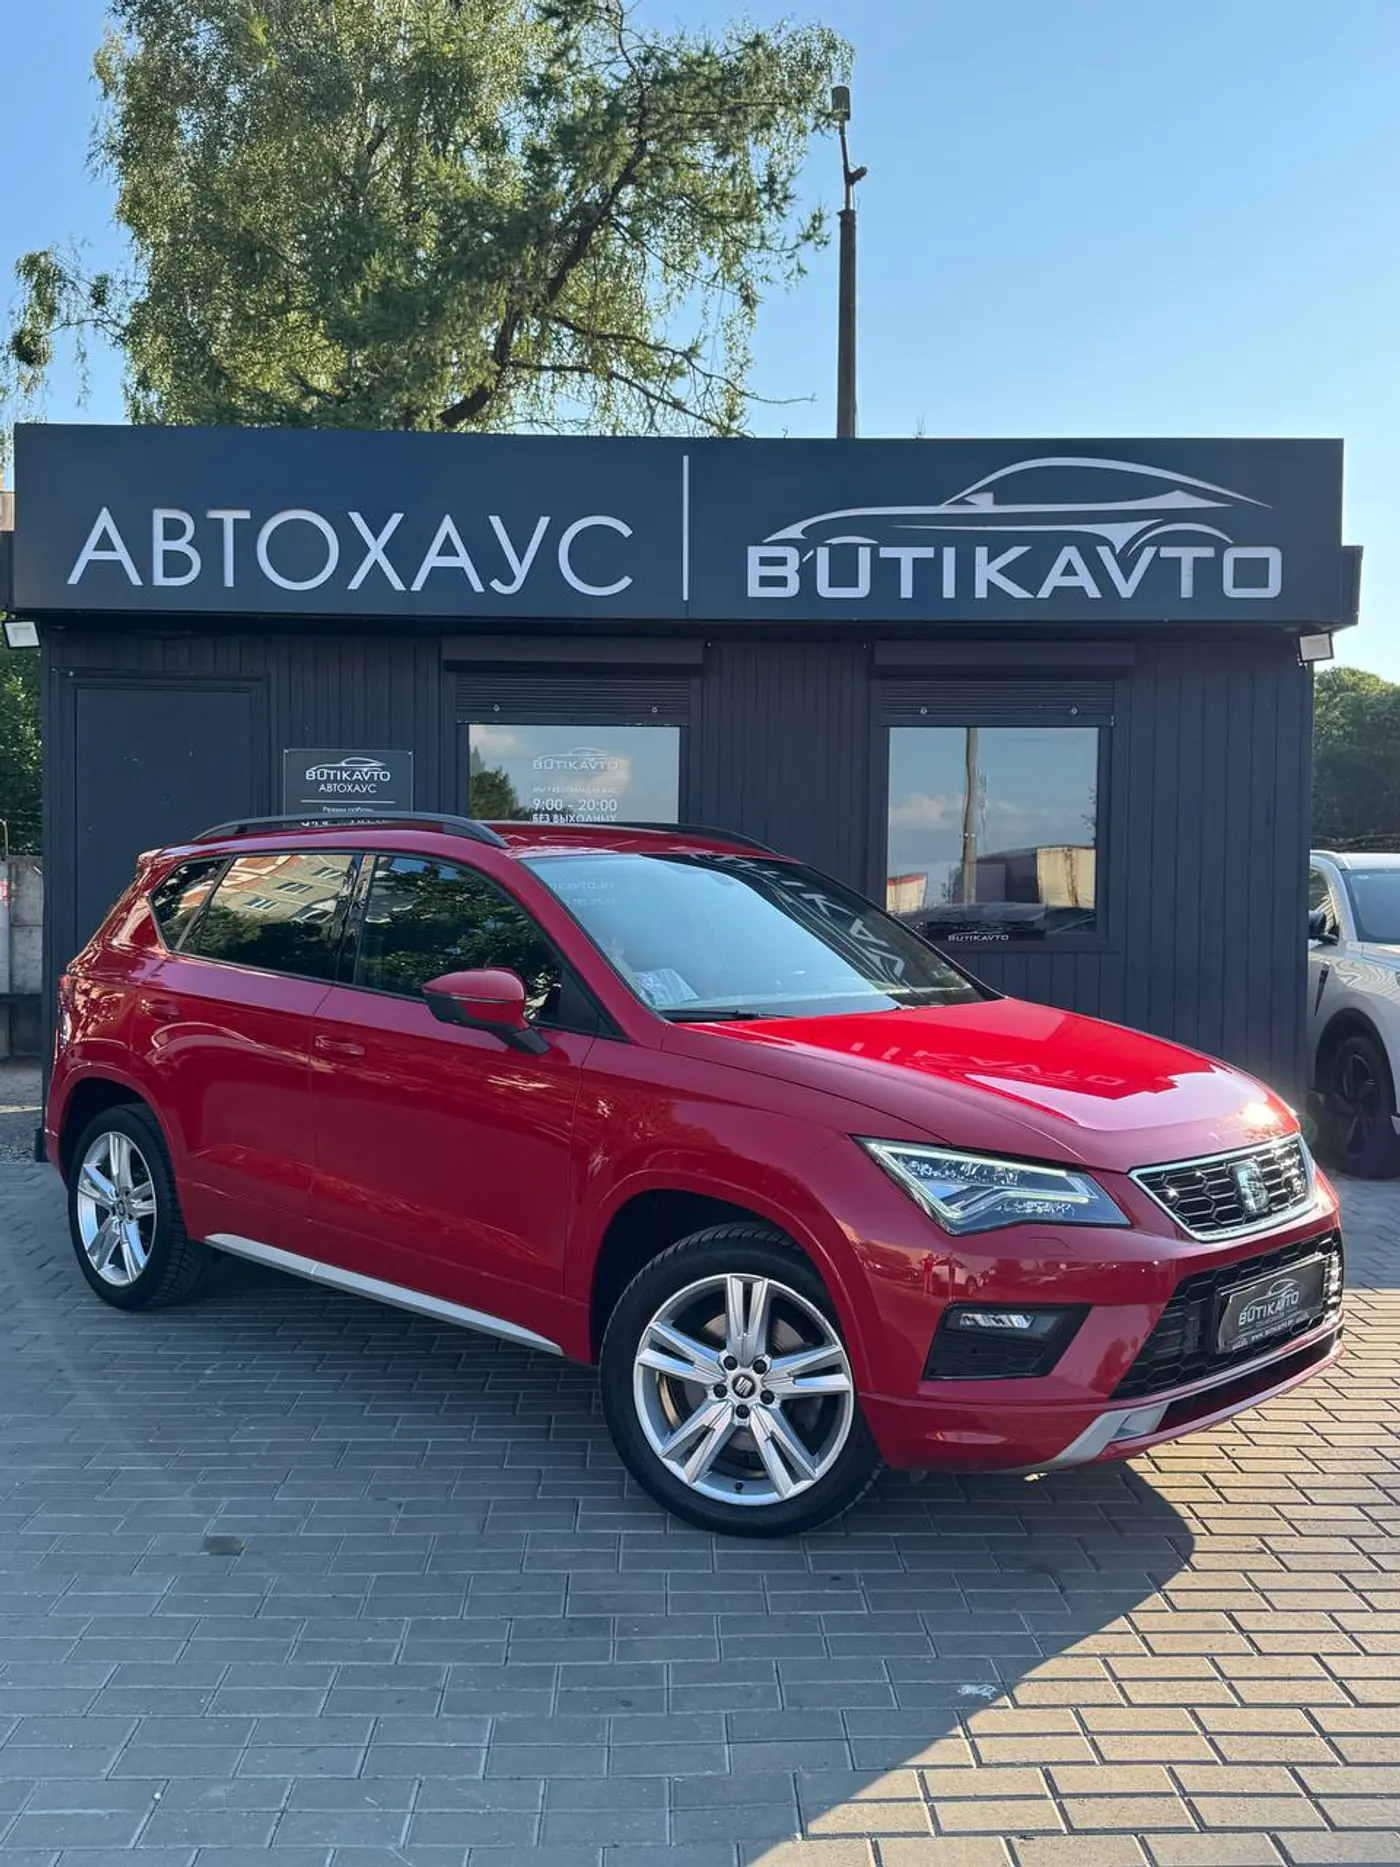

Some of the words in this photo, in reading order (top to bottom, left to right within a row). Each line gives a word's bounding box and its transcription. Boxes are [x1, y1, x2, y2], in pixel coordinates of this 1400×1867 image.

[67, 506, 634, 597] АВТОХАУС
[746, 545, 1282, 599] BUTIKAVTO
[533, 759, 618, 771] BUTIKAVTO
[305, 769, 391, 782] BUTIKAVTO
[318, 783, 377, 794] АВТОХАУС
[533, 798, 563, 811] 9:00
[578, 799, 617, 812] 20:00
[532, 814, 550, 824] БЕЗ
[552, 813, 617, 824] ВЫХОДНЫХ
[948, 933, 1009, 942] BUTIKAVTO
[1238, 1291, 1299, 1326] BUTIKAVTO
